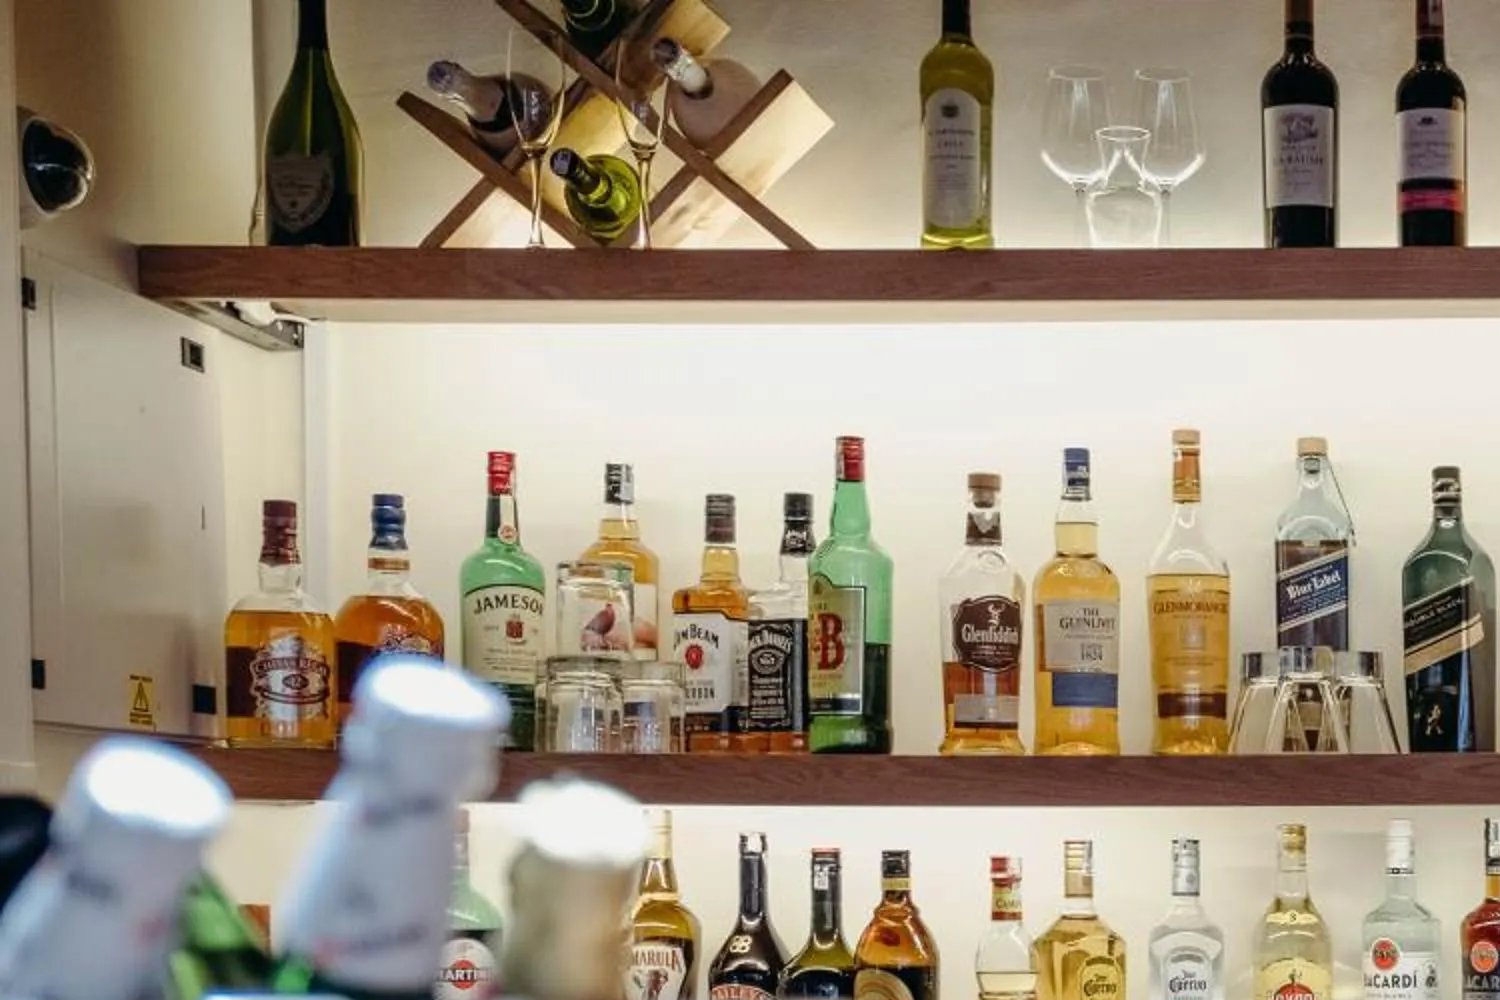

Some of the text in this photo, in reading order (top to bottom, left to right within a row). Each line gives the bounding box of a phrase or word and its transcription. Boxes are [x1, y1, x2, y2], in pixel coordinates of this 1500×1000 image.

[1286, 582, 1313, 600] Blue
[1312, 570, 1342, 590] Label
[689, 623, 720, 650] BEAM
[960, 622, 1020, 645] Glenfiddich
